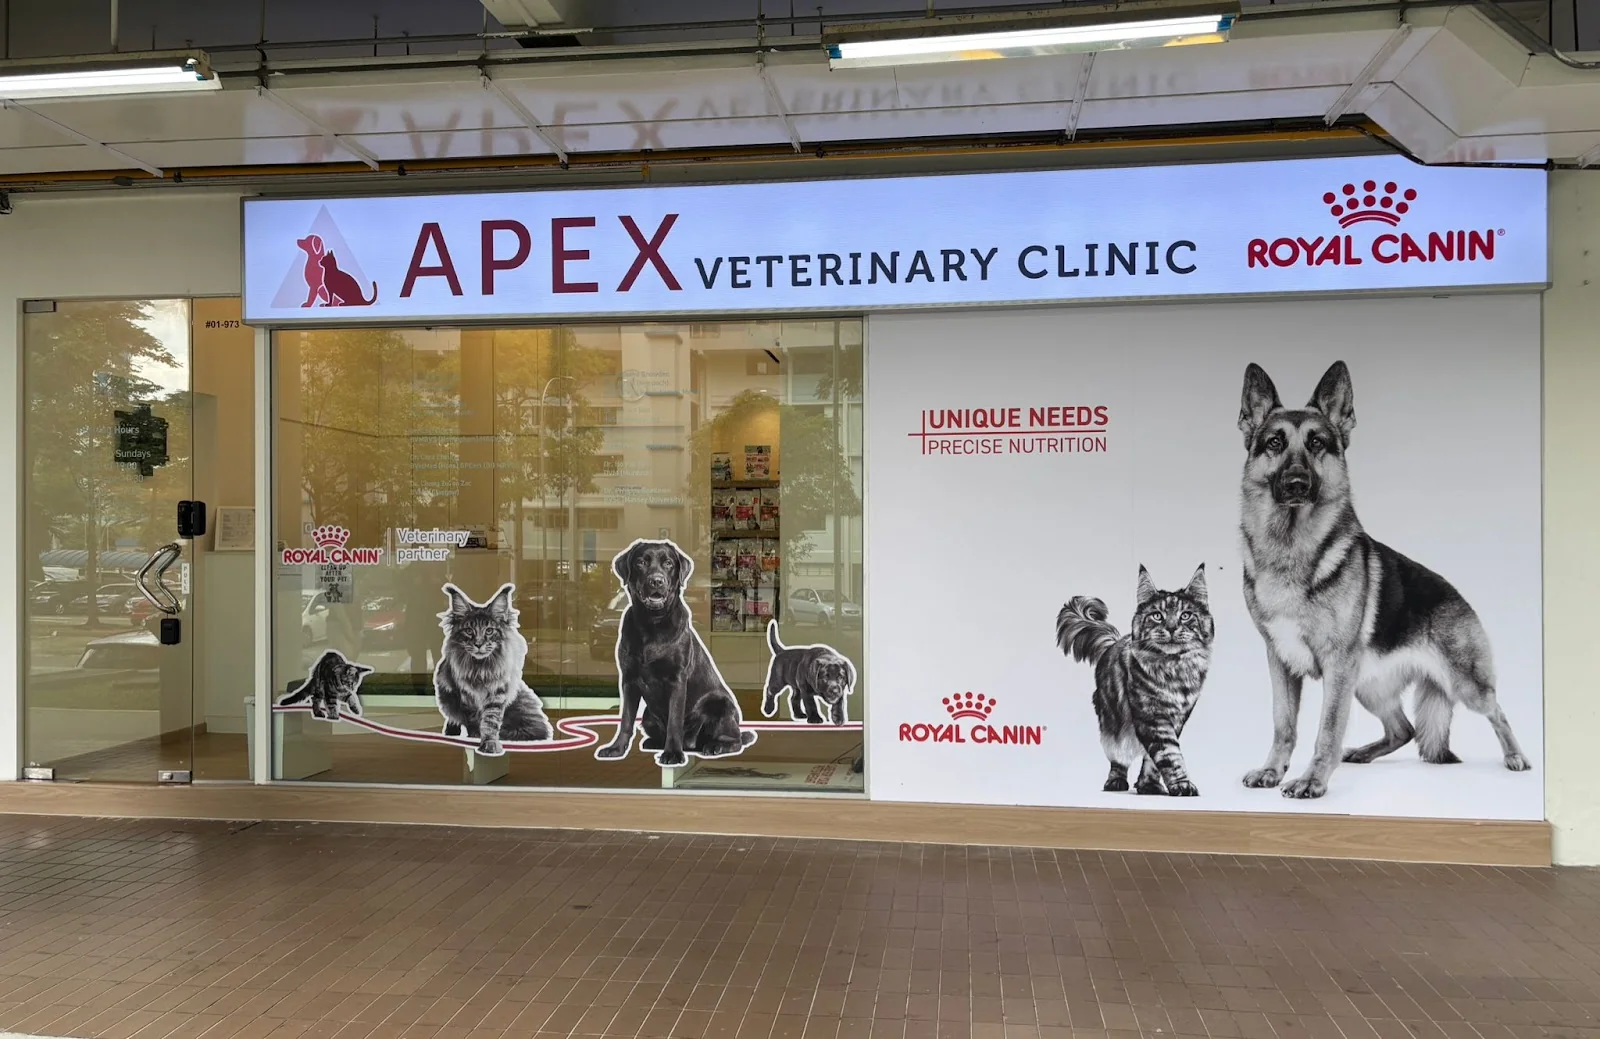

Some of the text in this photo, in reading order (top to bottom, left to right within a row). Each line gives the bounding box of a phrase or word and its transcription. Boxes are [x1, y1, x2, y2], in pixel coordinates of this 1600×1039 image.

[400, 213, 1198, 298] APEX VETERINARY CLINIC
[1247, 228, 1495, 268] ROYAL CANIN
[205, 320, 240, 328] #01-973
[929, 406, 1109, 429] UNIQUE NEEDS
[114, 425, 140, 434] Hours
[115, 449, 152, 459] Sundays
[928, 436, 1108, 455] PRECISE NUTRITION
[398, 529, 469, 547] Veterinary
[283, 550, 380, 564] ROYAL CANIN
[398, 549, 448, 562] partner
[899, 723, 1042, 745] ROYAL CANIN
